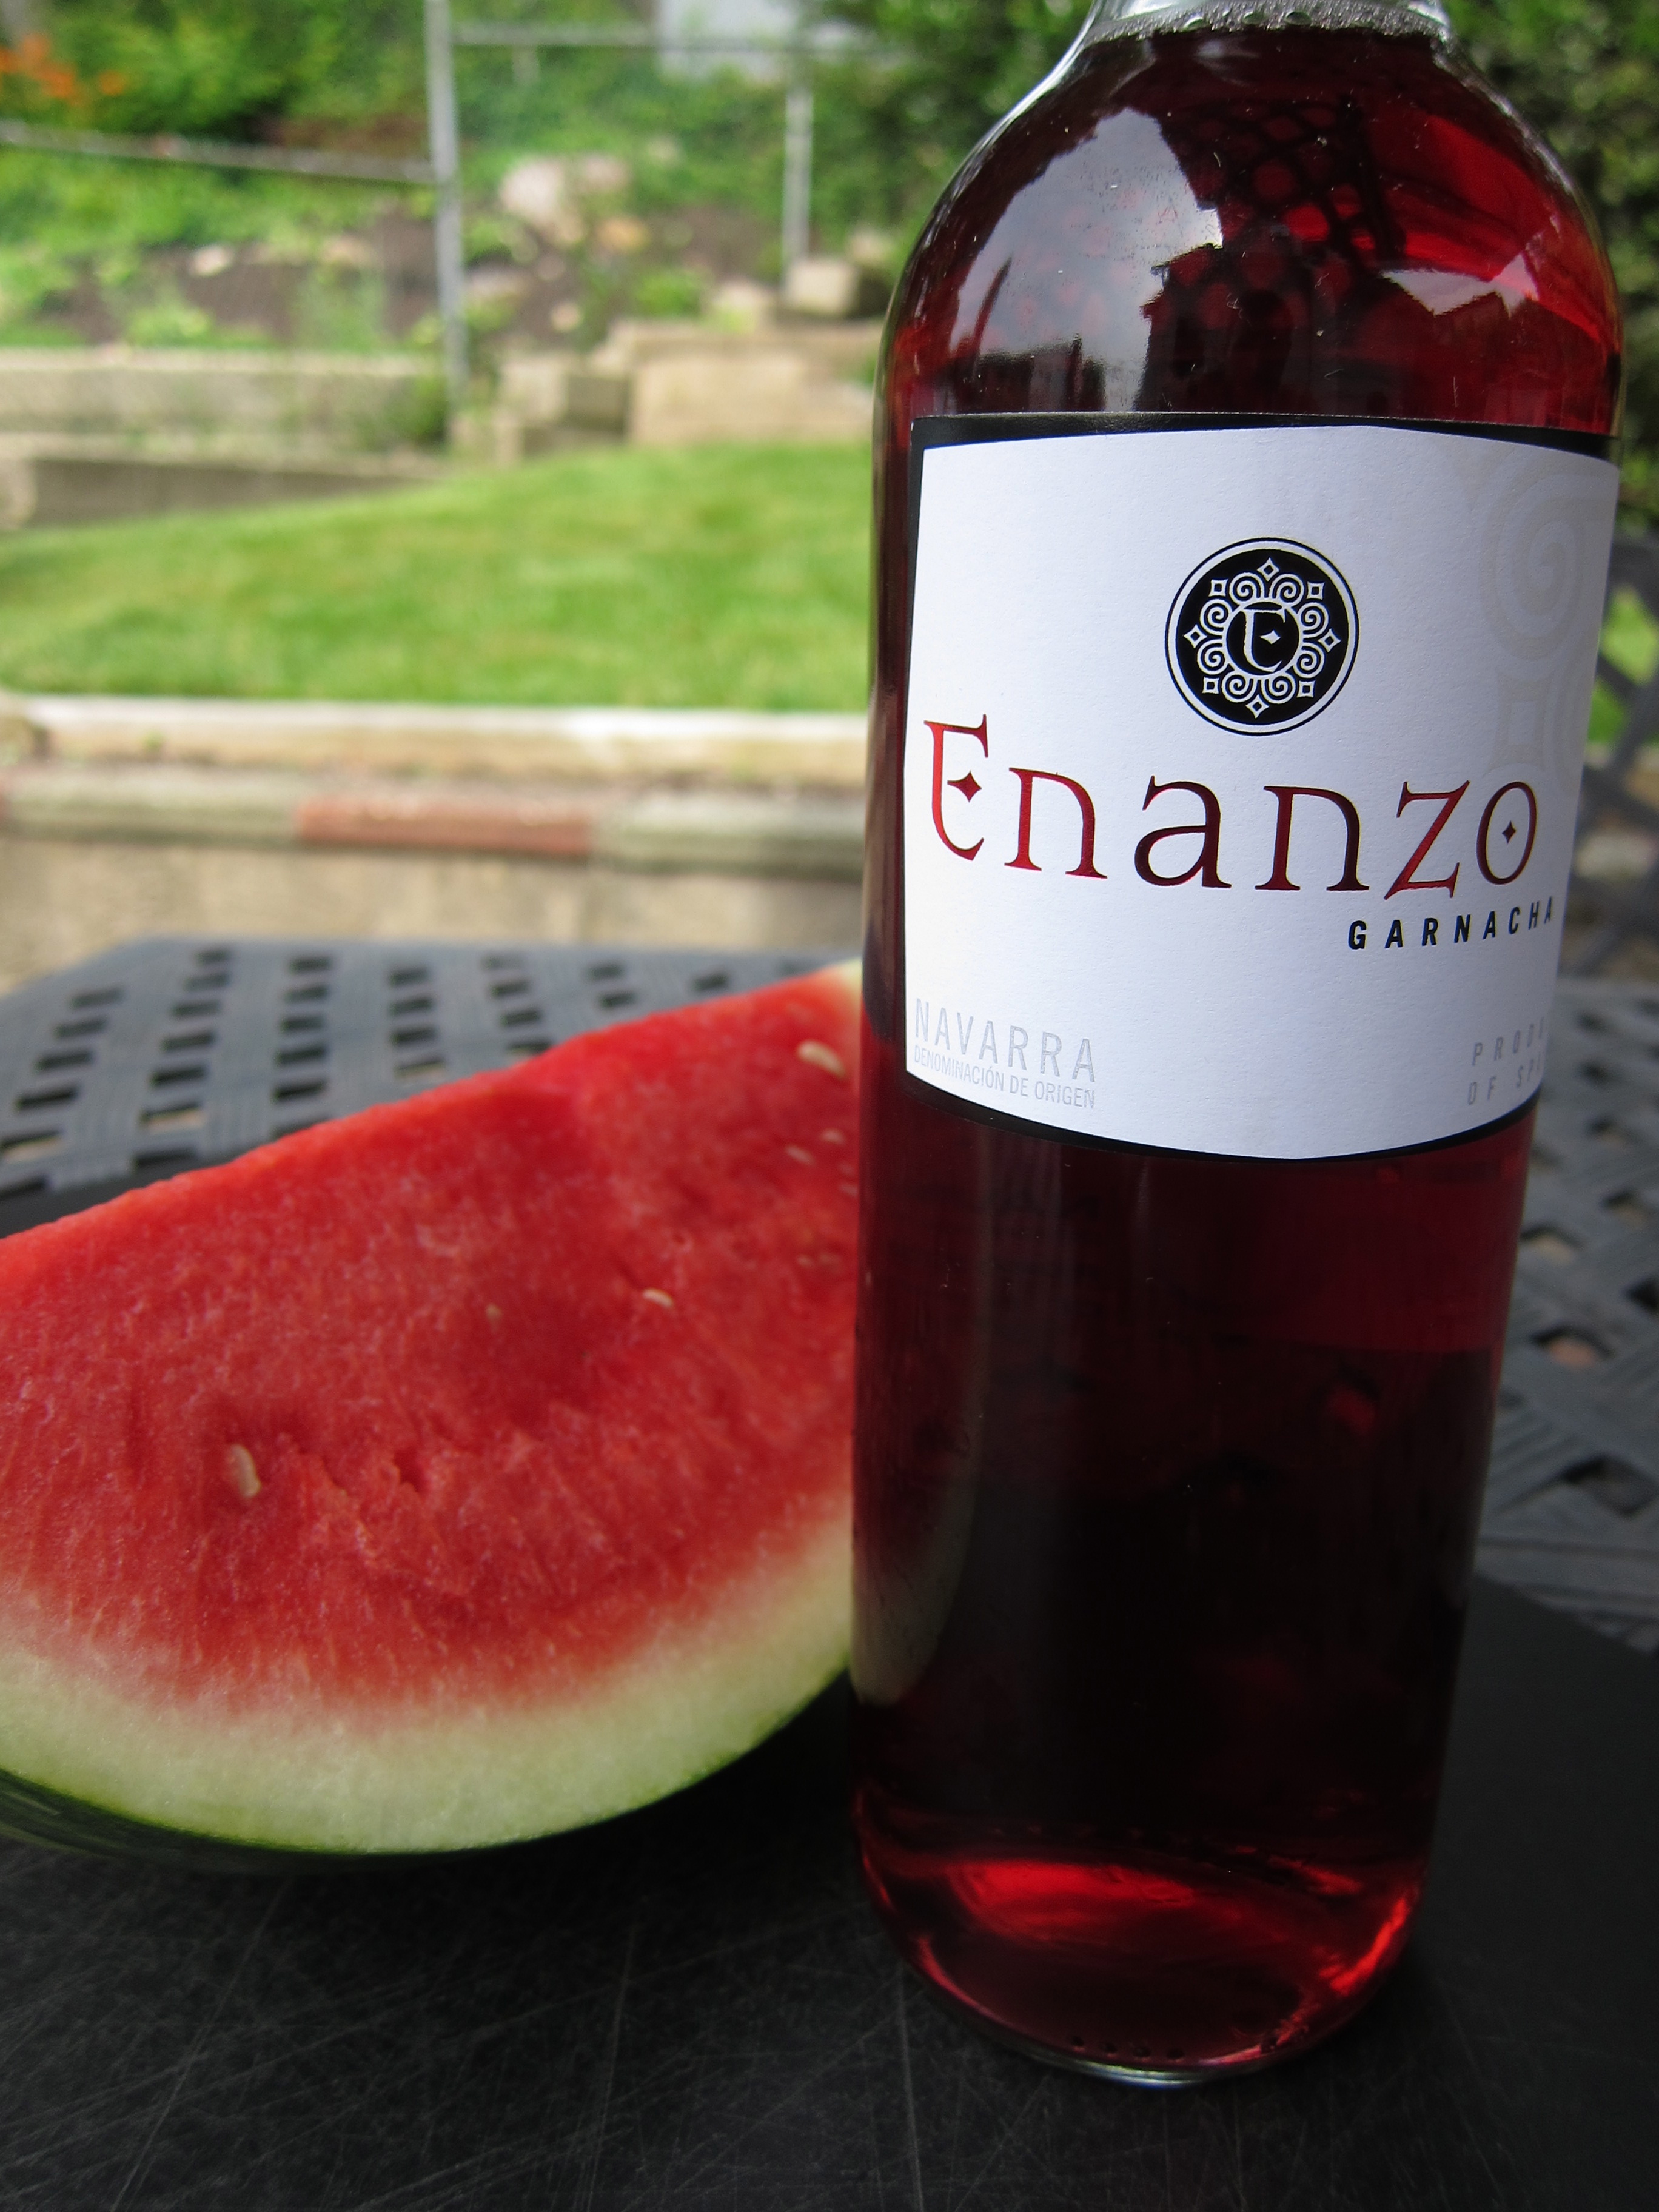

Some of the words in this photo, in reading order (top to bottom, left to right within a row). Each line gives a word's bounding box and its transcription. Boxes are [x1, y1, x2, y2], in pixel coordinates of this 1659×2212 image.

[924, 714, 1537, 899] Enanzo
[1348, 896, 1552, 950] GARNACHA
[916, 998, 1095, 1082] NAVARRA
[914, 1045, 1004, 1091] DENOMINACIÓN
[1010, 1075, 1029, 1097] DE
[1034, 1081, 1095, 1108] ORIGEN
[1467, 1076, 1496, 1105] OF
